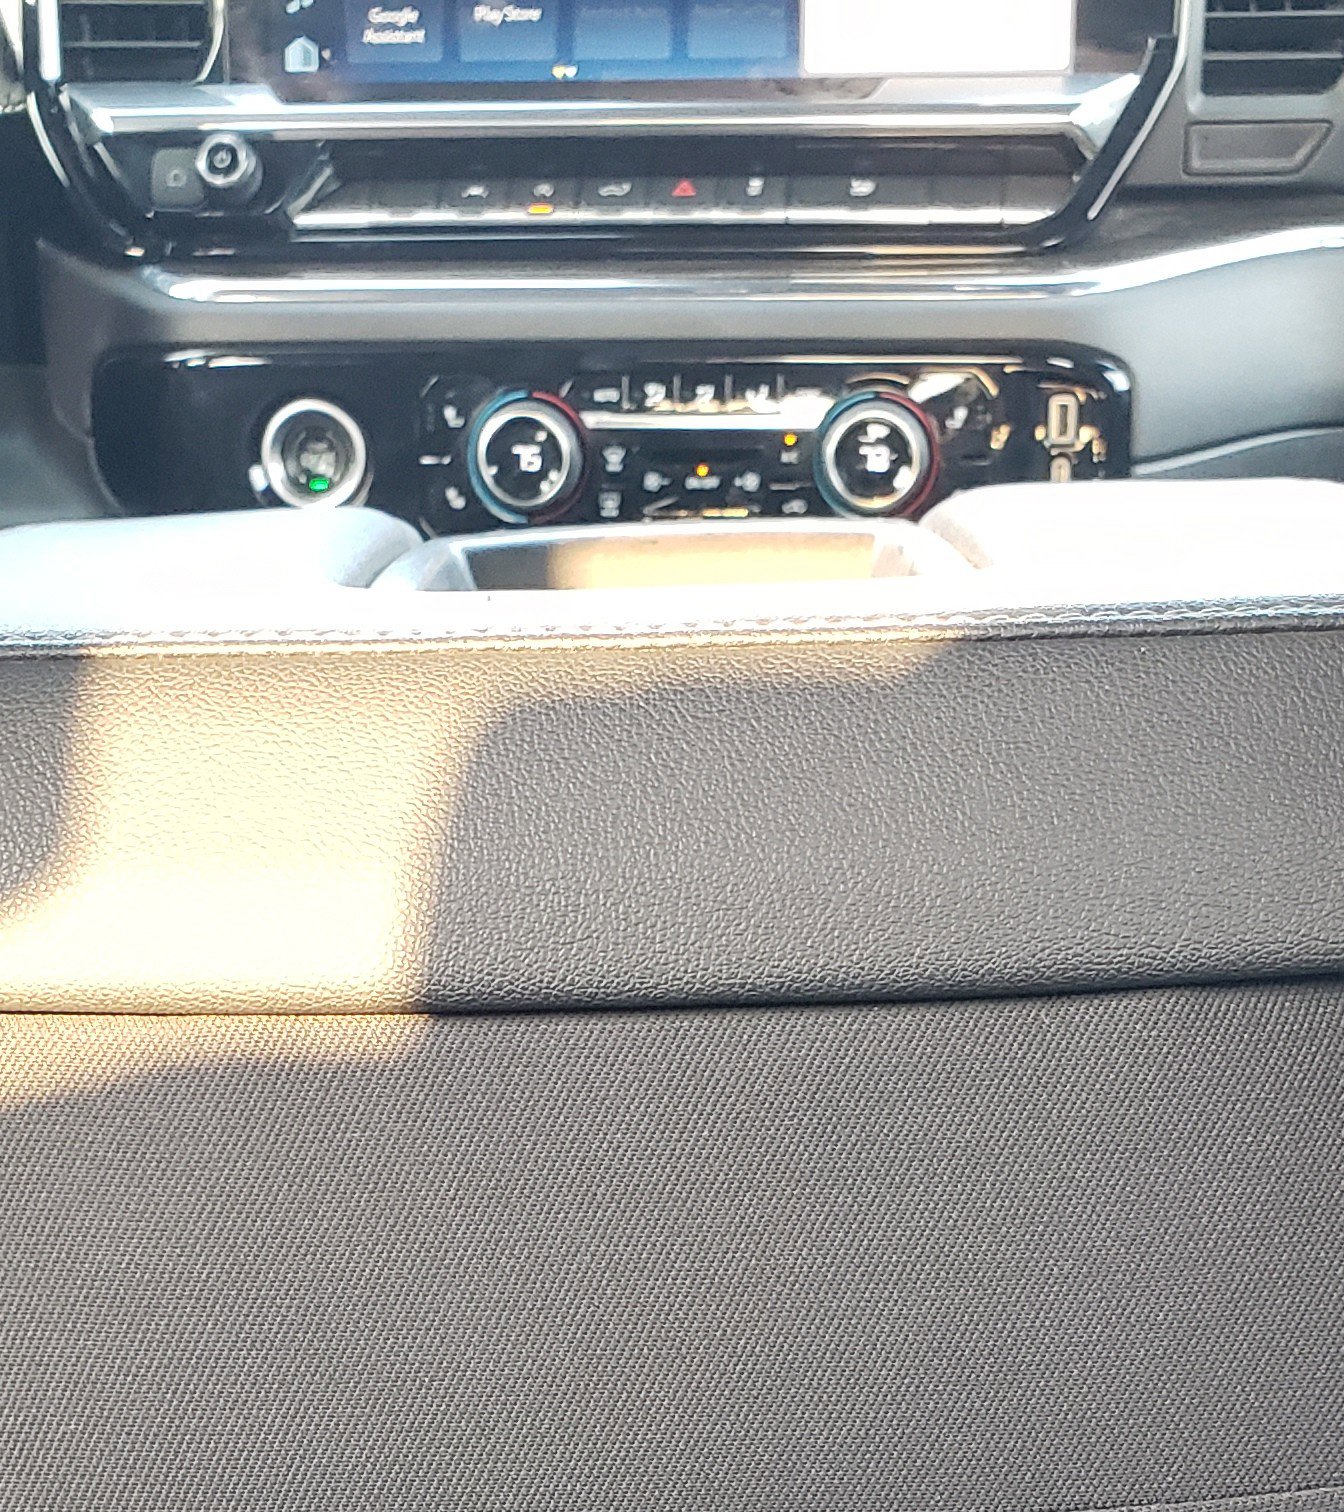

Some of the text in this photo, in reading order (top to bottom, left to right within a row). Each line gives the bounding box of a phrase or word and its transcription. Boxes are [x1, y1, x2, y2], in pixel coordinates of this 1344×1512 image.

[368, 6, 420, 27] Google
[473, 5, 543, 27] Play Store
